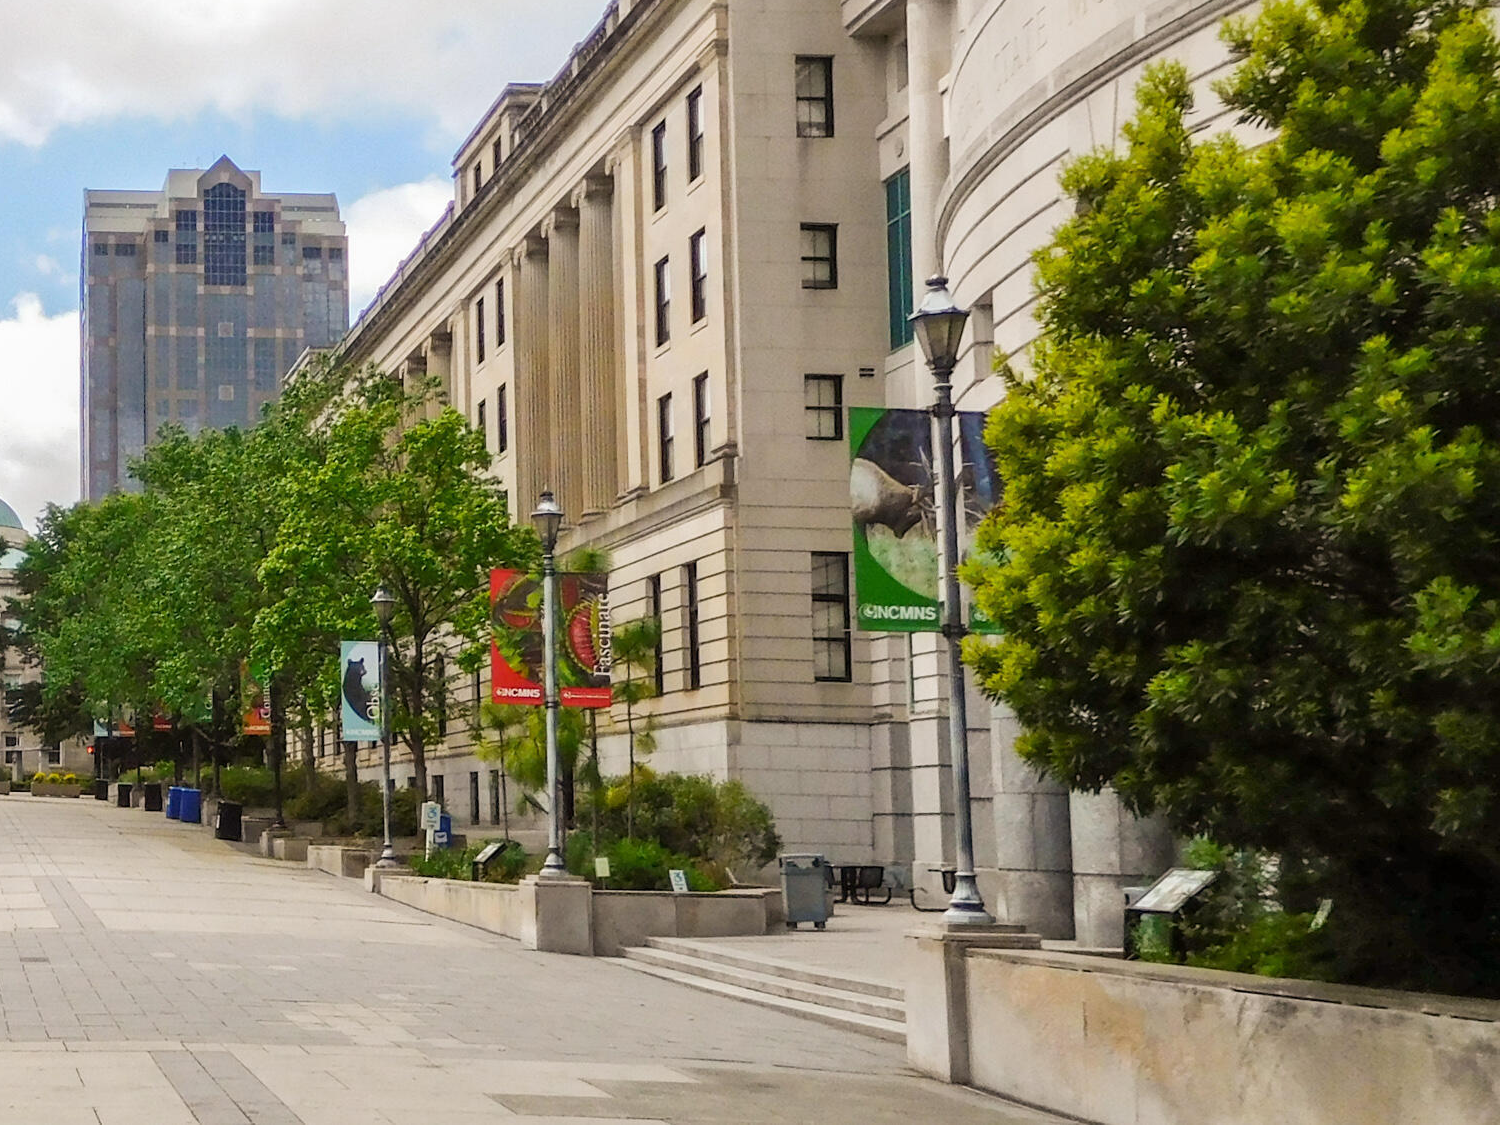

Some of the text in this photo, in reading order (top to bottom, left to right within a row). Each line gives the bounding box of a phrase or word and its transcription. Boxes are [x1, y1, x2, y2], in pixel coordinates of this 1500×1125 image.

[878, 605, 937, 621] NCMNS
[593, 593, 612, 677] Fascinate
[505, 687, 541, 698] NCMNS
